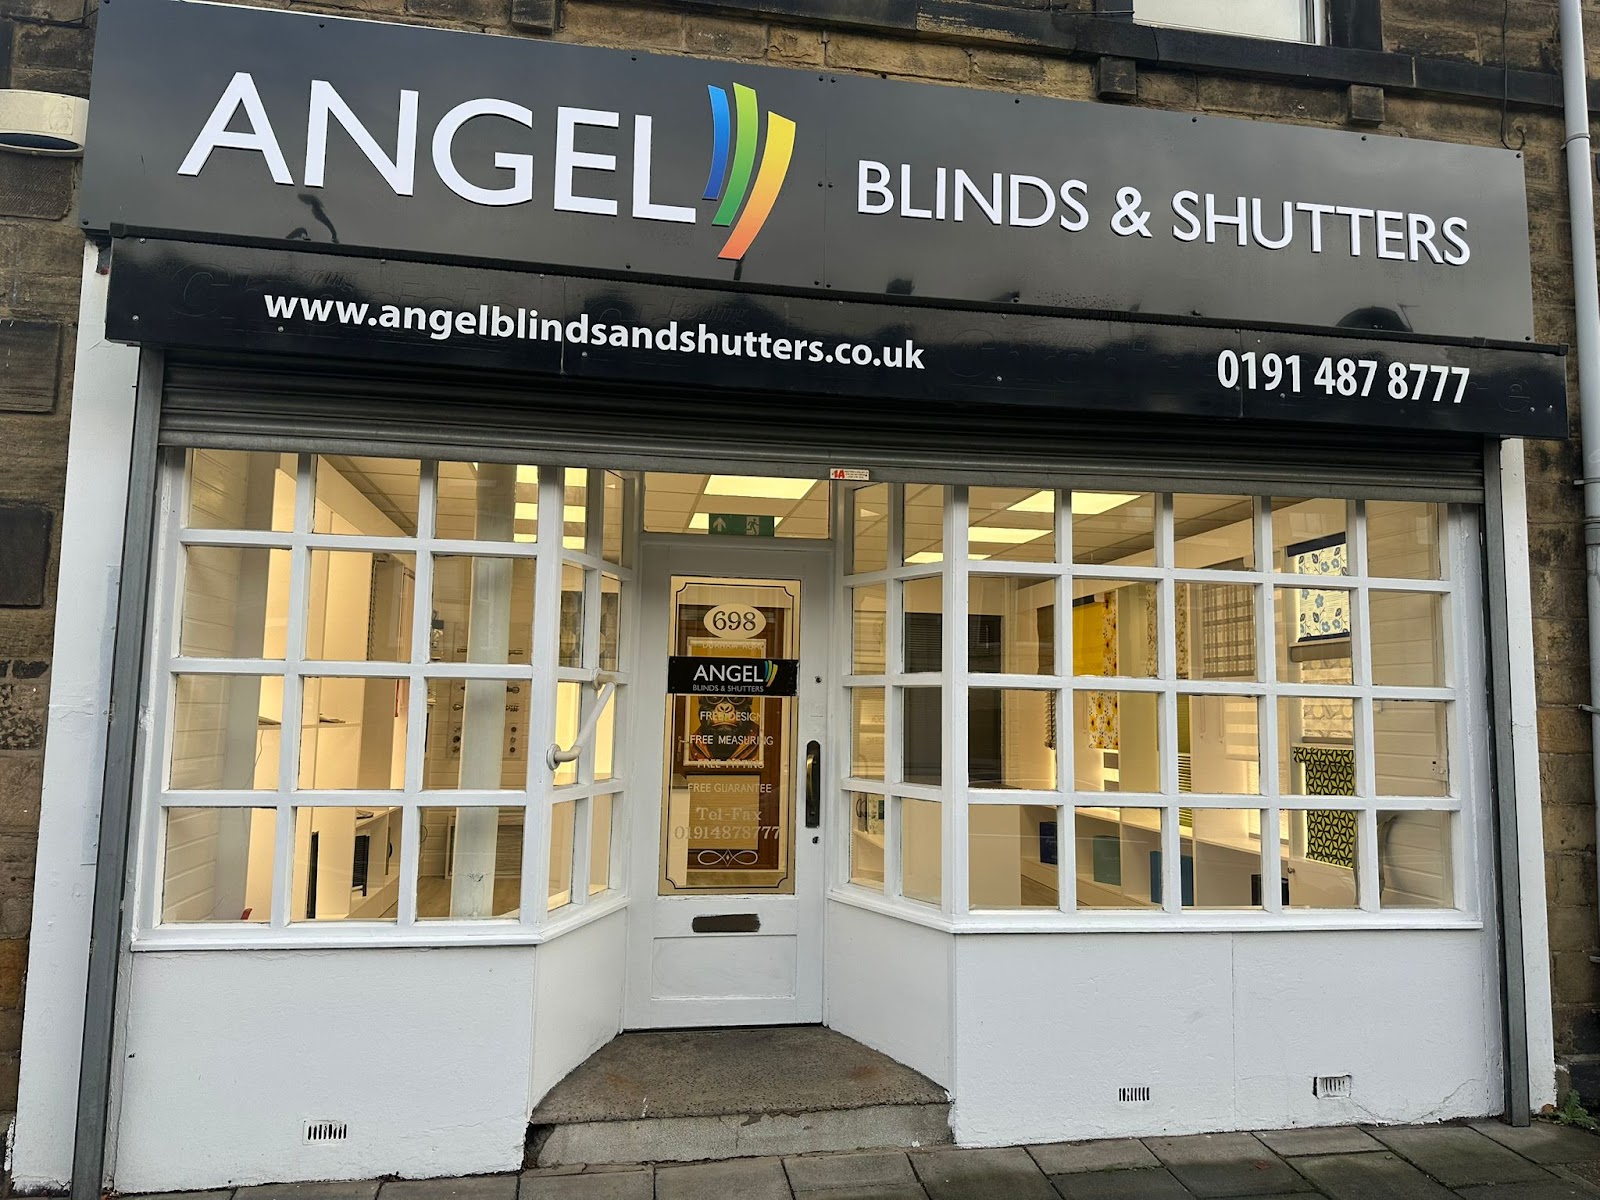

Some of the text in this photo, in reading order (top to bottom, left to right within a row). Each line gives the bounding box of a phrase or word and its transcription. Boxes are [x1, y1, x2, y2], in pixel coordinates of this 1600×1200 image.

[177, 71, 697, 225] ANGEL
[857, 159, 1471, 266] BLINDS & SHUTTERS
[263, 293, 926, 371] www.angelblindsandshutters.co.uk
[1216, 350, 1471, 404] 0191 487 8777
[712, 610, 756, 632] 698
[693, 664, 764, 683] ANGEL
[692, 684, 719, 692] BLINDS
[727, 685, 764, 693] SHUTTERS
[700, 711, 762, 722] FREE DESIGN
[689, 734, 774, 746] FREE MEASURING
[697, 758, 722, 769] FREE
[687, 783, 772, 793] FREE GUARANTEE
[674, 826, 781, 840] 01914878777
